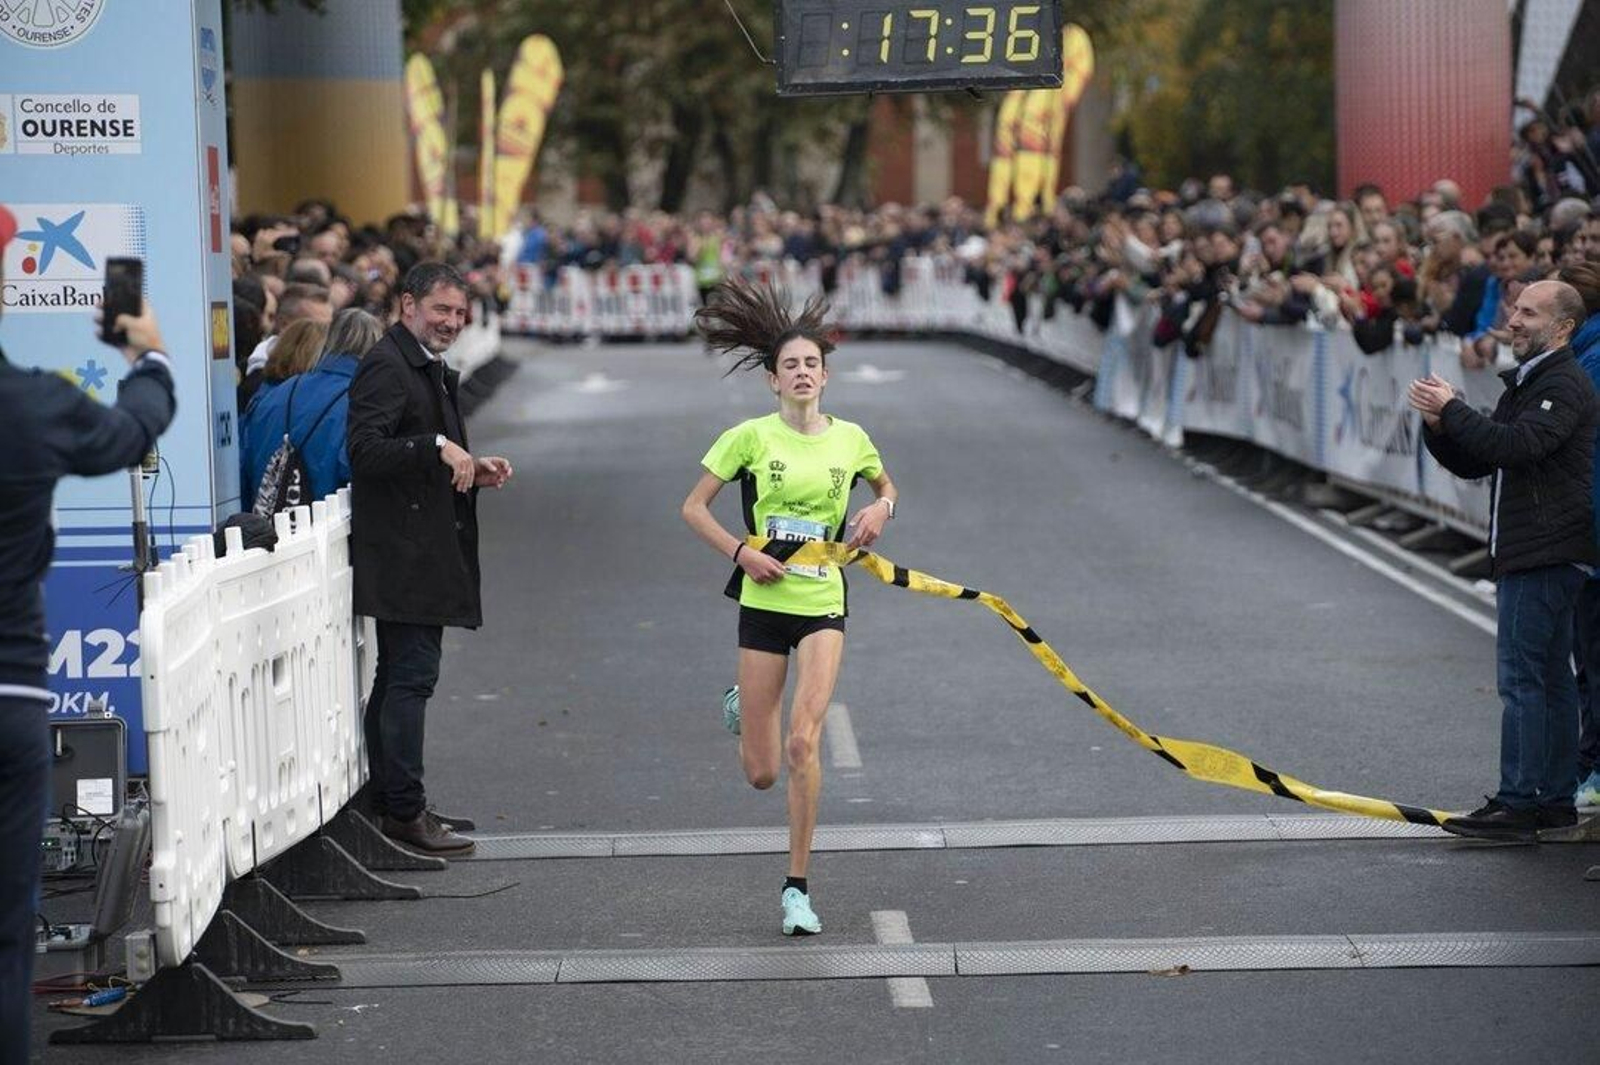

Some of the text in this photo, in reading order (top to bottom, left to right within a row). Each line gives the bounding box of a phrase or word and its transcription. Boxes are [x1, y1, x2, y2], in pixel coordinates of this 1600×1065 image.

[75, 0, 95, 23] TES
[17, 26, 71, 43] OURENSE
[20, 98, 116, 113] Concello de
[22, 119, 135, 137] OURENSE
[53, 142, 109, 156] Deportes
[2, 284, 105, 306] CaixaBan
